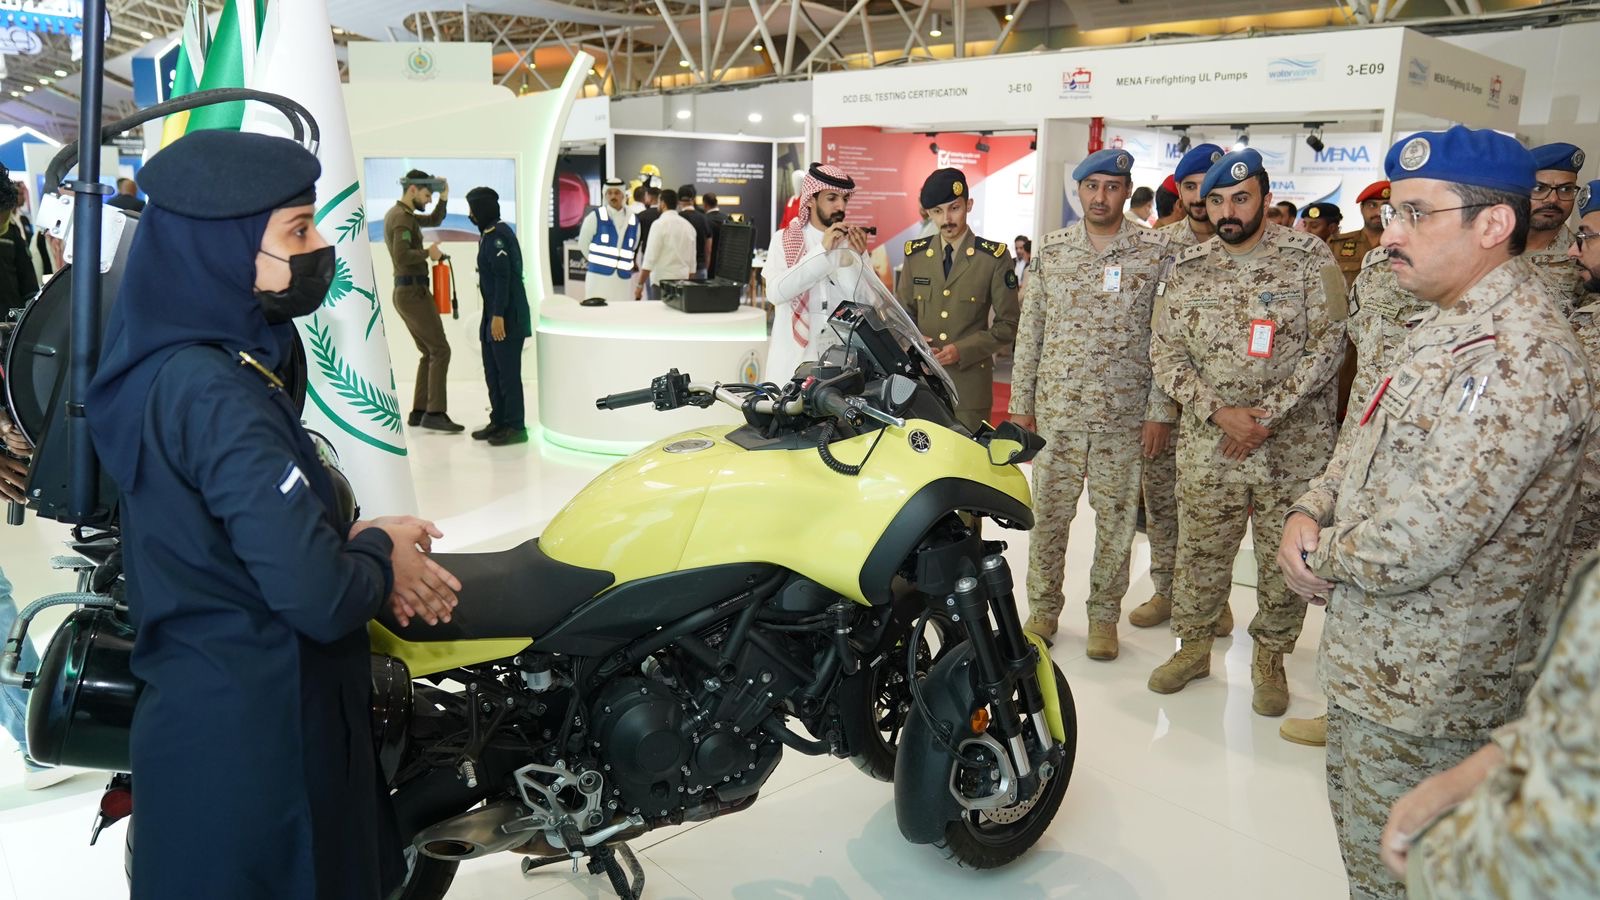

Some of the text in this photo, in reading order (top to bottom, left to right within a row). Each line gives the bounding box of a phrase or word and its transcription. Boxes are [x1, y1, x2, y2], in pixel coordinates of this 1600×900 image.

[1346, 63, 1385, 76] 3-E09
[1116, 71, 1248, 86] MENA Firefighting UL Pumps
[843, 87, 968, 104] DCD ESL TESTING CERTIFICATION
[1008, 83, 1032, 94] 3-E10
[1314, 145, 1370, 163] MENA
